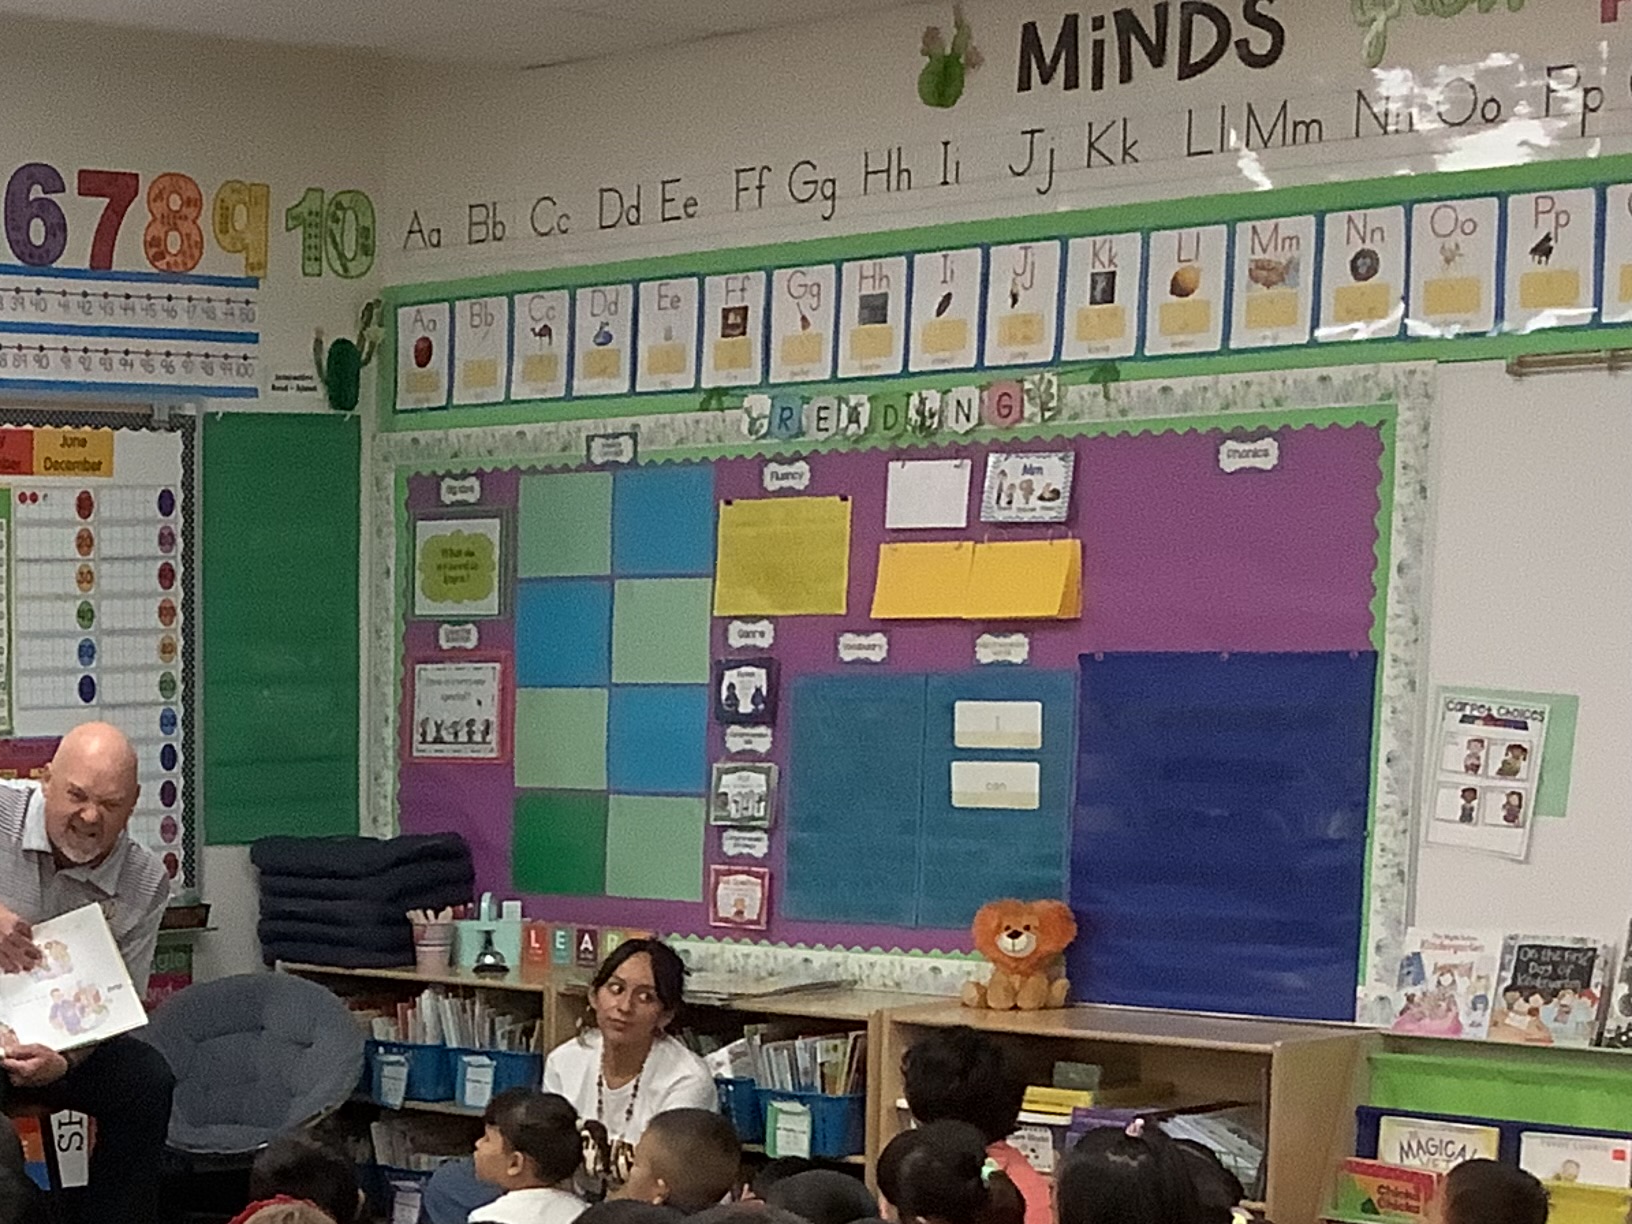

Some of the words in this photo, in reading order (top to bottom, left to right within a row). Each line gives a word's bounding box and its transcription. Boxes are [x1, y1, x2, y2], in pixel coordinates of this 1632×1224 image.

[403, 209, 441, 249] Aa
[468, 201, 506, 245] Bb
[530, 196, 570, 237] Cc
[597, 184, 641, 230] Dd
[660, 177, 699, 222] Ee
[734, 165, 772, 211] Ff
[788, 160, 836, 220] Gg
[863, 146, 912, 196] Hh
[940, 141, 960, 186] Ii
[1008, 128, 1055, 195] Jj
[1087, 116, 1140, 168] Kk
[1186, 104, 1226, 157] Ll
[1245, 99, 1323, 149] Mm
[1355, 88, 1413, 138] Nn
[1437, 77, 1501, 127] Oo
[1546, 64, 1604, 138] Pp
[4, 162, 68, 266] 6
[77, 169, 140, 272] 7
[143, 172, 205, 274] 8
[212, 179, 269, 278] 9
[285, 187, 376, 279] 10
[411, 308, 437, 332] Aa
[469, 301, 495, 328] Bb
[528, 294, 556, 321] Cc
[589, 288, 619, 317] Dd
[657, 282, 681, 311] Ee
[724, 276, 750, 304] Ff
[787, 270, 821, 310] Gg
[857, 261, 890, 292] Hh
[939, 253, 955, 283] Ii
[1012, 245, 1036, 290] Jj
[1091, 239, 1118, 269] Kk
[1176, 231, 1201, 263] Ll
[1250, 222, 1300, 257] Mm
[1346, 213, 1385, 246] Nn
[1430, 204, 1477, 239] Oo
[1533, 195, 1570, 244] Pp
[60, 435, 88, 448] June
[43, 456, 103, 472] December
[770, 469, 805, 482] Fluency
[737, 627, 767, 640] Genre
